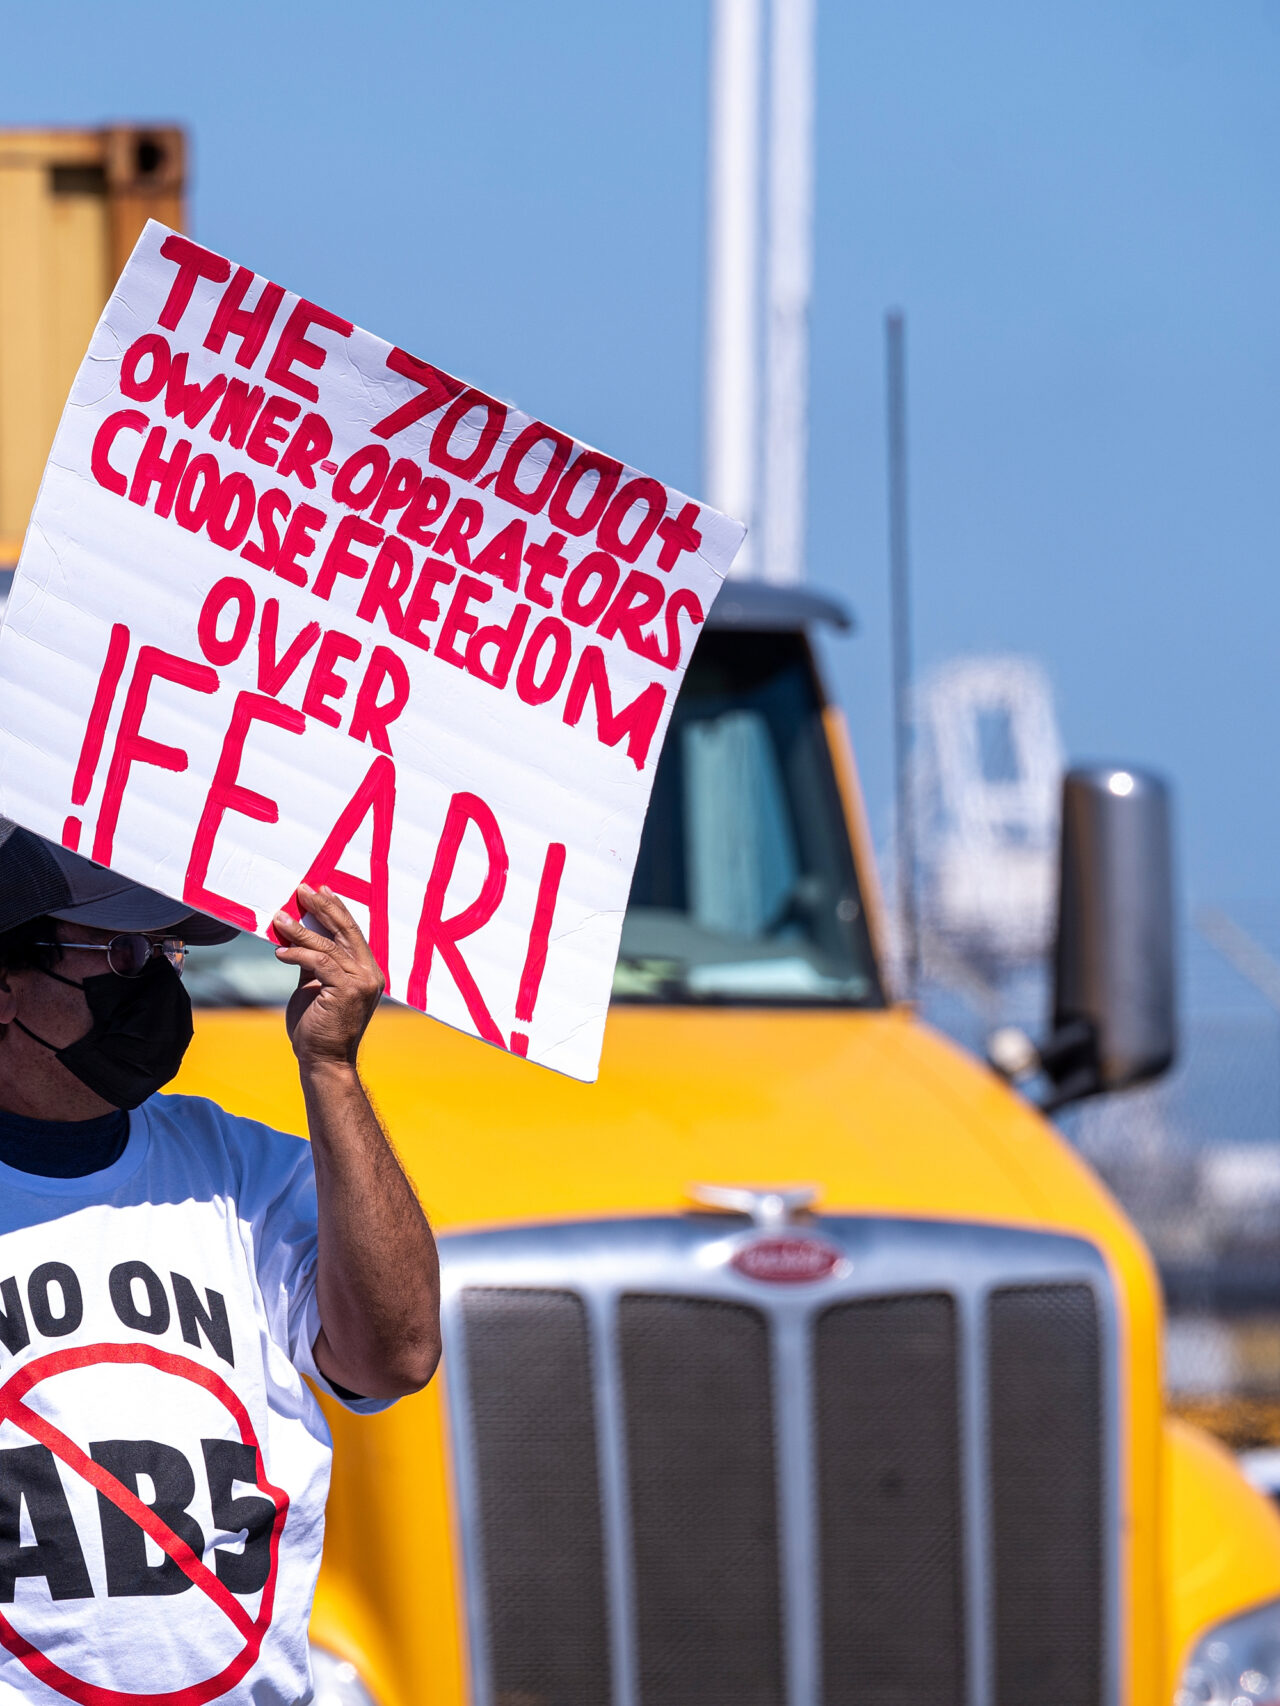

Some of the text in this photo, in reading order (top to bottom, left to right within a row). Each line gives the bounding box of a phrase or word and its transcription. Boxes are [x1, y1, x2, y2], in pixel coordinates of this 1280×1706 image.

[157, 234, 355, 404] THE
[370, 346, 703, 573] 70,000+
[197, 575, 411, 758] OVER
[108, 1260, 235, 1370] ON
